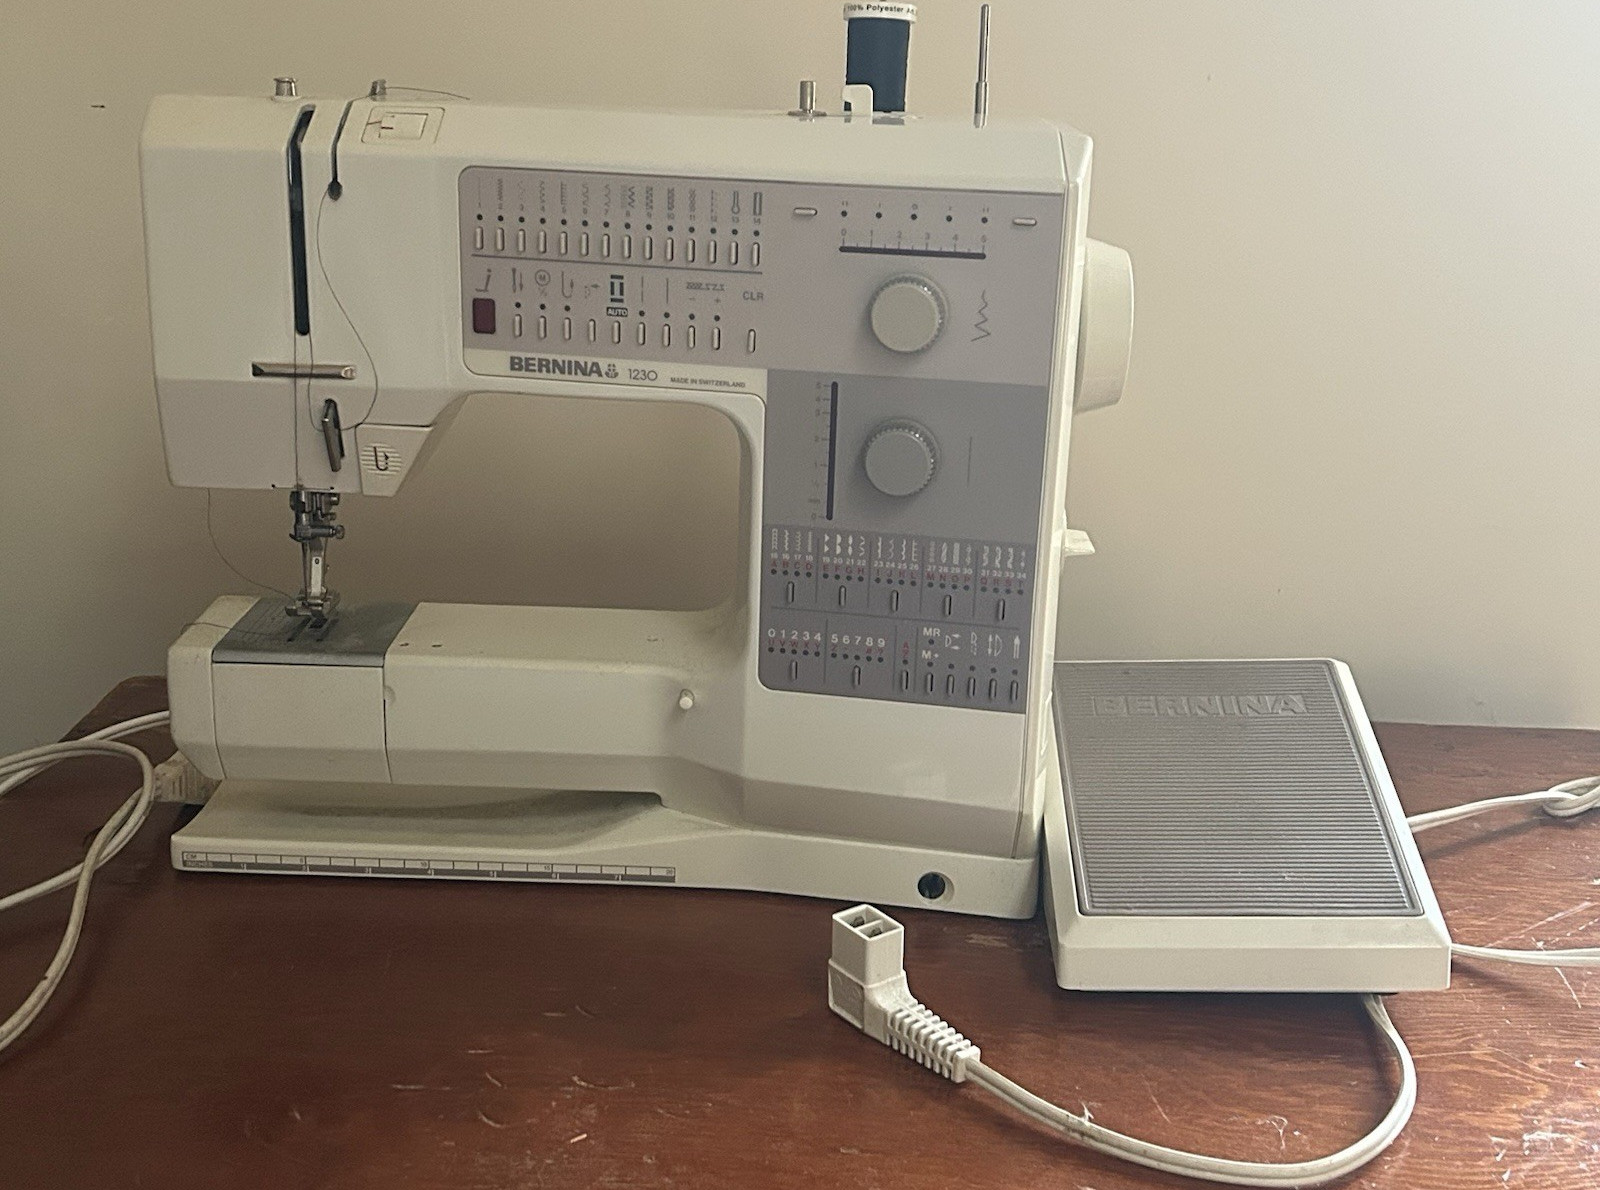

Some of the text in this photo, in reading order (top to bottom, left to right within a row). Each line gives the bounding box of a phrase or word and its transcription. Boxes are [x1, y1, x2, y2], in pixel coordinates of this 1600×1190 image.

[848, 4, 864, 12] 100%
[866, 4, 904, 13] Polyester
[742, 291, 764, 301] CLR
[607, 308, 628, 316] AUTO
[509, 356, 603, 378] BERNINA
[628, 368, 658, 382] 1230
[699, 379, 746, 388] SWITZERLAND
[768, 628, 821, 641] 0 1 2 3 4
[923, 627, 941, 637] MR
[831, 633, 886, 648] 5 6 7 8 9
[1092, 695, 1308, 718] BERNINA
